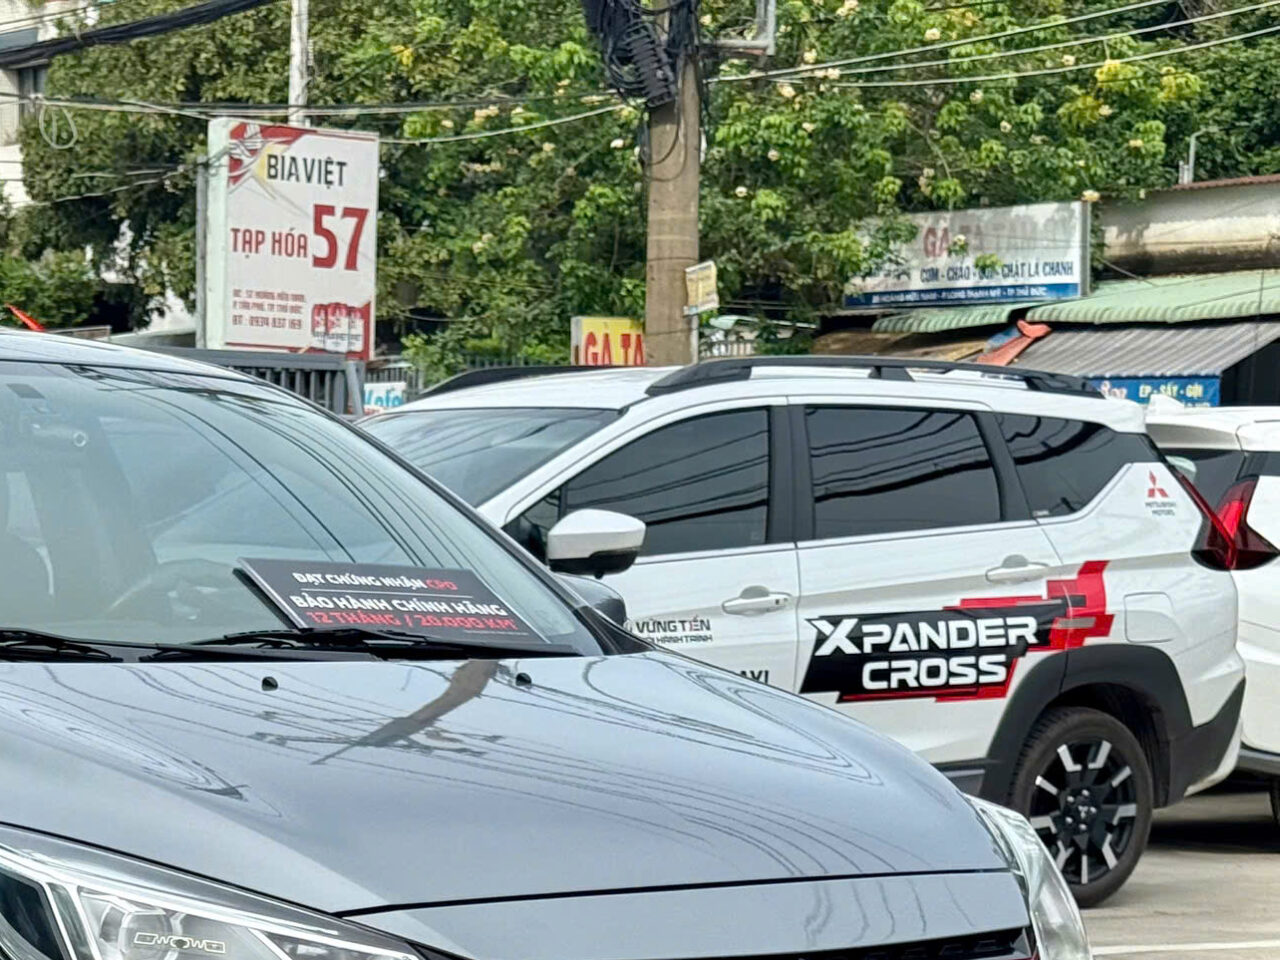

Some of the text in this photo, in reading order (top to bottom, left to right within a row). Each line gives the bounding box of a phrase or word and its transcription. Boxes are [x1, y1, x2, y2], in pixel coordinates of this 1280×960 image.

[231, 204, 369, 271] TẠP HÓA 57
[292, 573, 325, 585] ĐẠT
[325, 573, 382, 586] CHỨNG
[289, 592, 509, 616] BẢO HÀNH CHÍNH HÃNG
[306, 612, 333, 624] 12
[329, 609, 402, 625] THÁNG
[810, 616, 1039, 656] XPANDER
[862, 654, 1007, 690] CROSS
